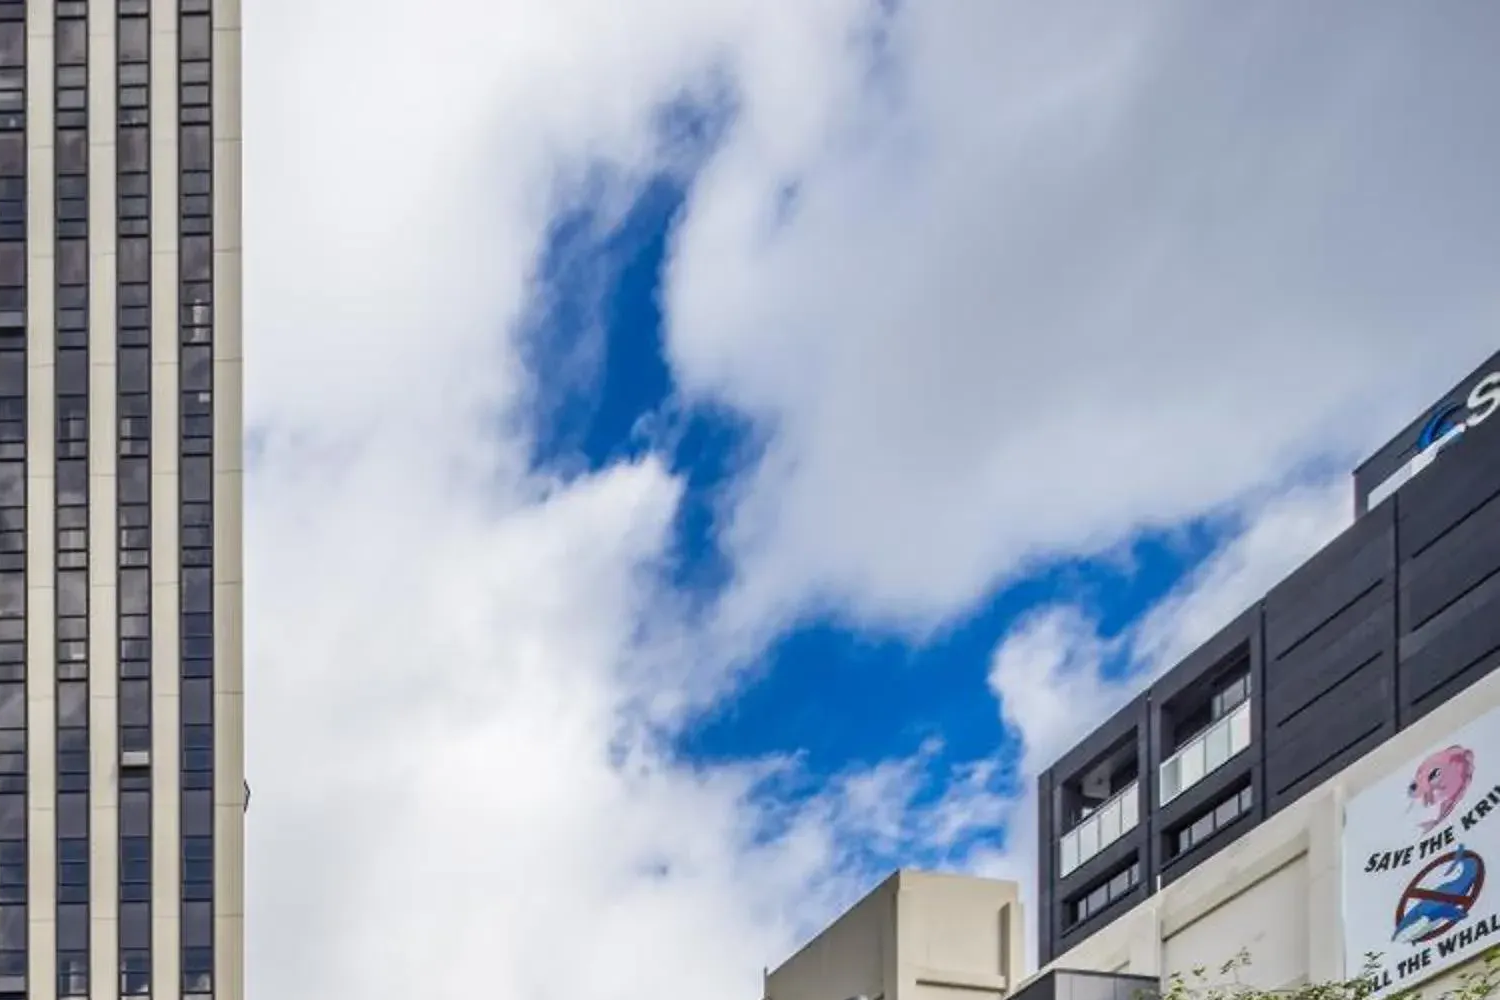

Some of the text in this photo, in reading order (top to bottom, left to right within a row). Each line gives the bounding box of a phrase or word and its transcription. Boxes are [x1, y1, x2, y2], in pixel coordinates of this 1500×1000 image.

[1364, 845, 1414, 873] SAVE
[1419, 825, 1454, 860] THE
[1397, 948, 1432, 979] THE
